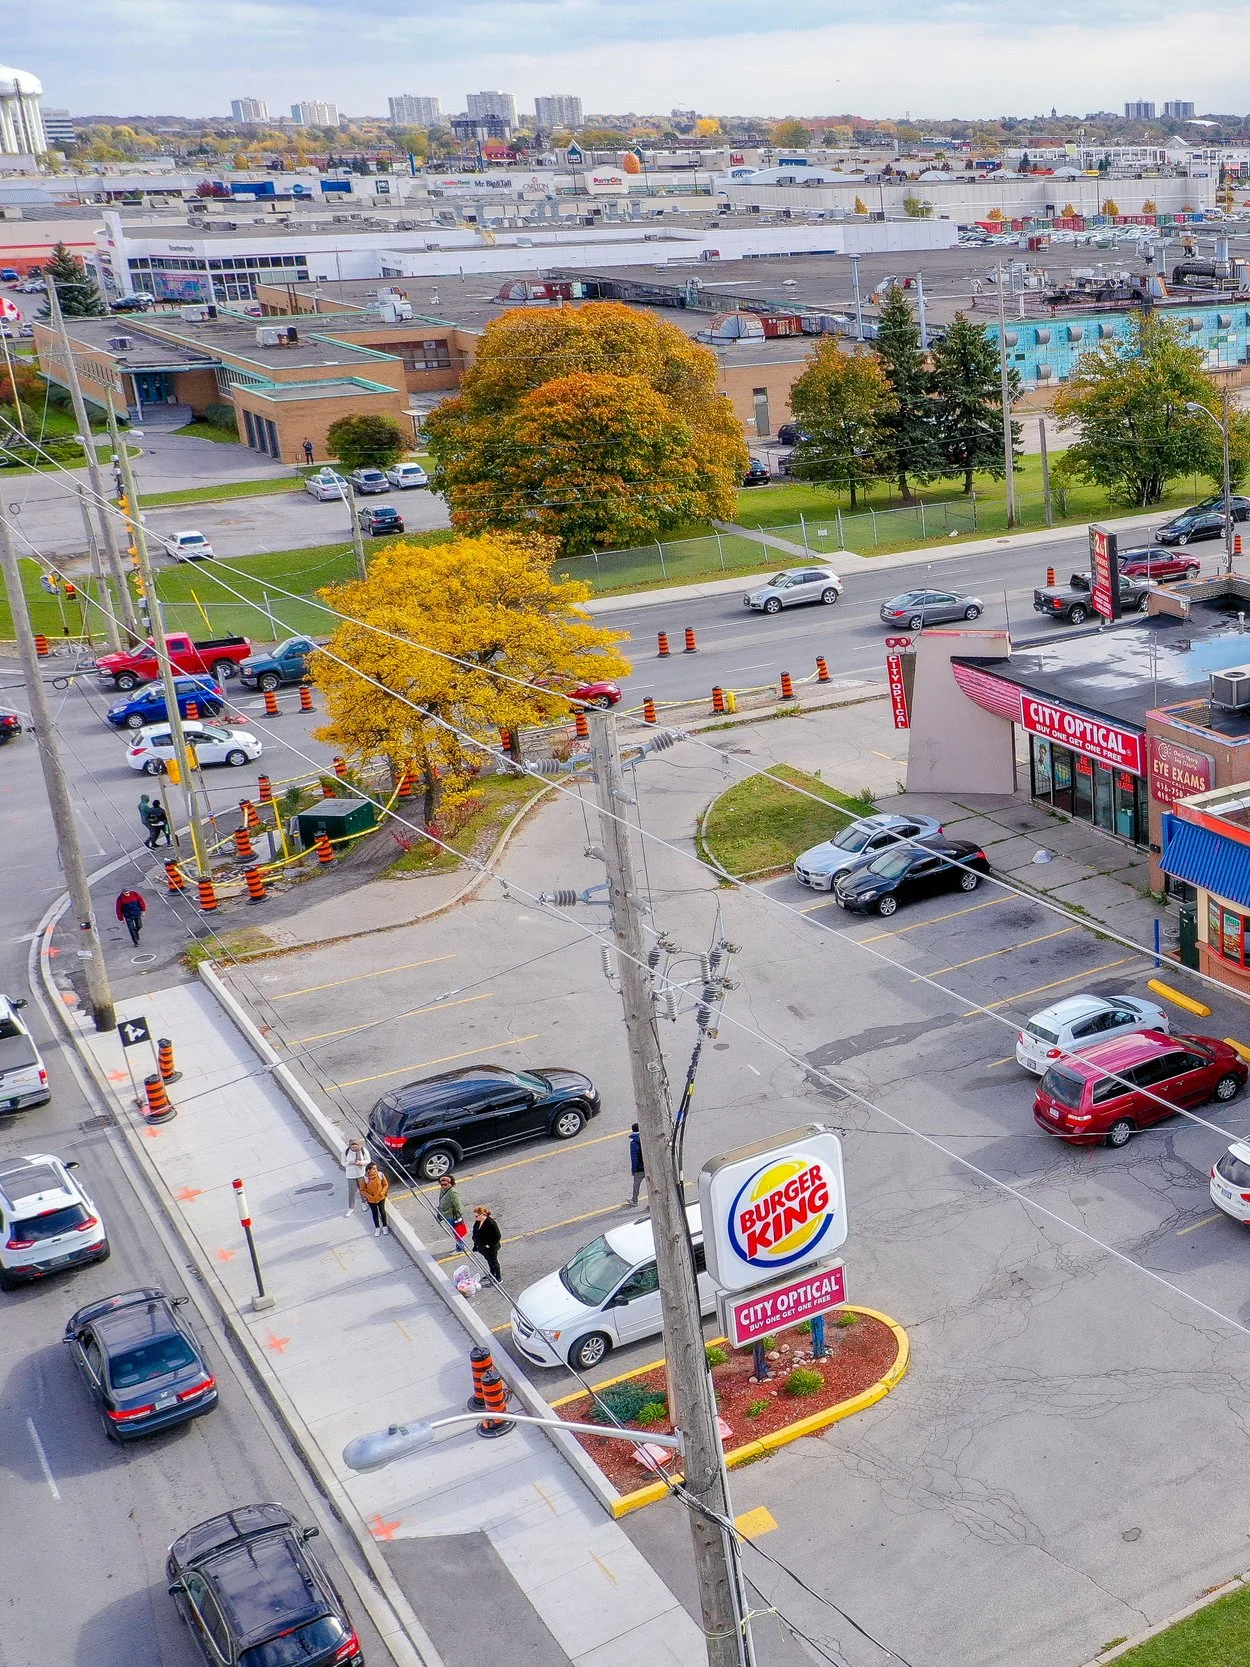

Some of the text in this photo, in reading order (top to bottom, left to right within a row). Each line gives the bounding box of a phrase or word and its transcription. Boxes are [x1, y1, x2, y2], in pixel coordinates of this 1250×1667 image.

[888, 656, 906, 728] CITY OPTICAL
[1030, 703, 1126, 755] CITY OPTICAL
[1036, 723, 1122, 763] BUY ONE GET ONE FREE
[1153, 759, 1205, 791] EYE EXAMS
[1156, 781, 1190, 797] 416-750-
[1172, 781, 1186, 790] CALL
[740, 1165, 823, 1234] BURGER
[747, 1182, 828, 1258] KING
[740, 1276, 839, 1325] CITY OPTICAL
[749, 1294, 831, 1332] BUY ONE GET ONE FREE
